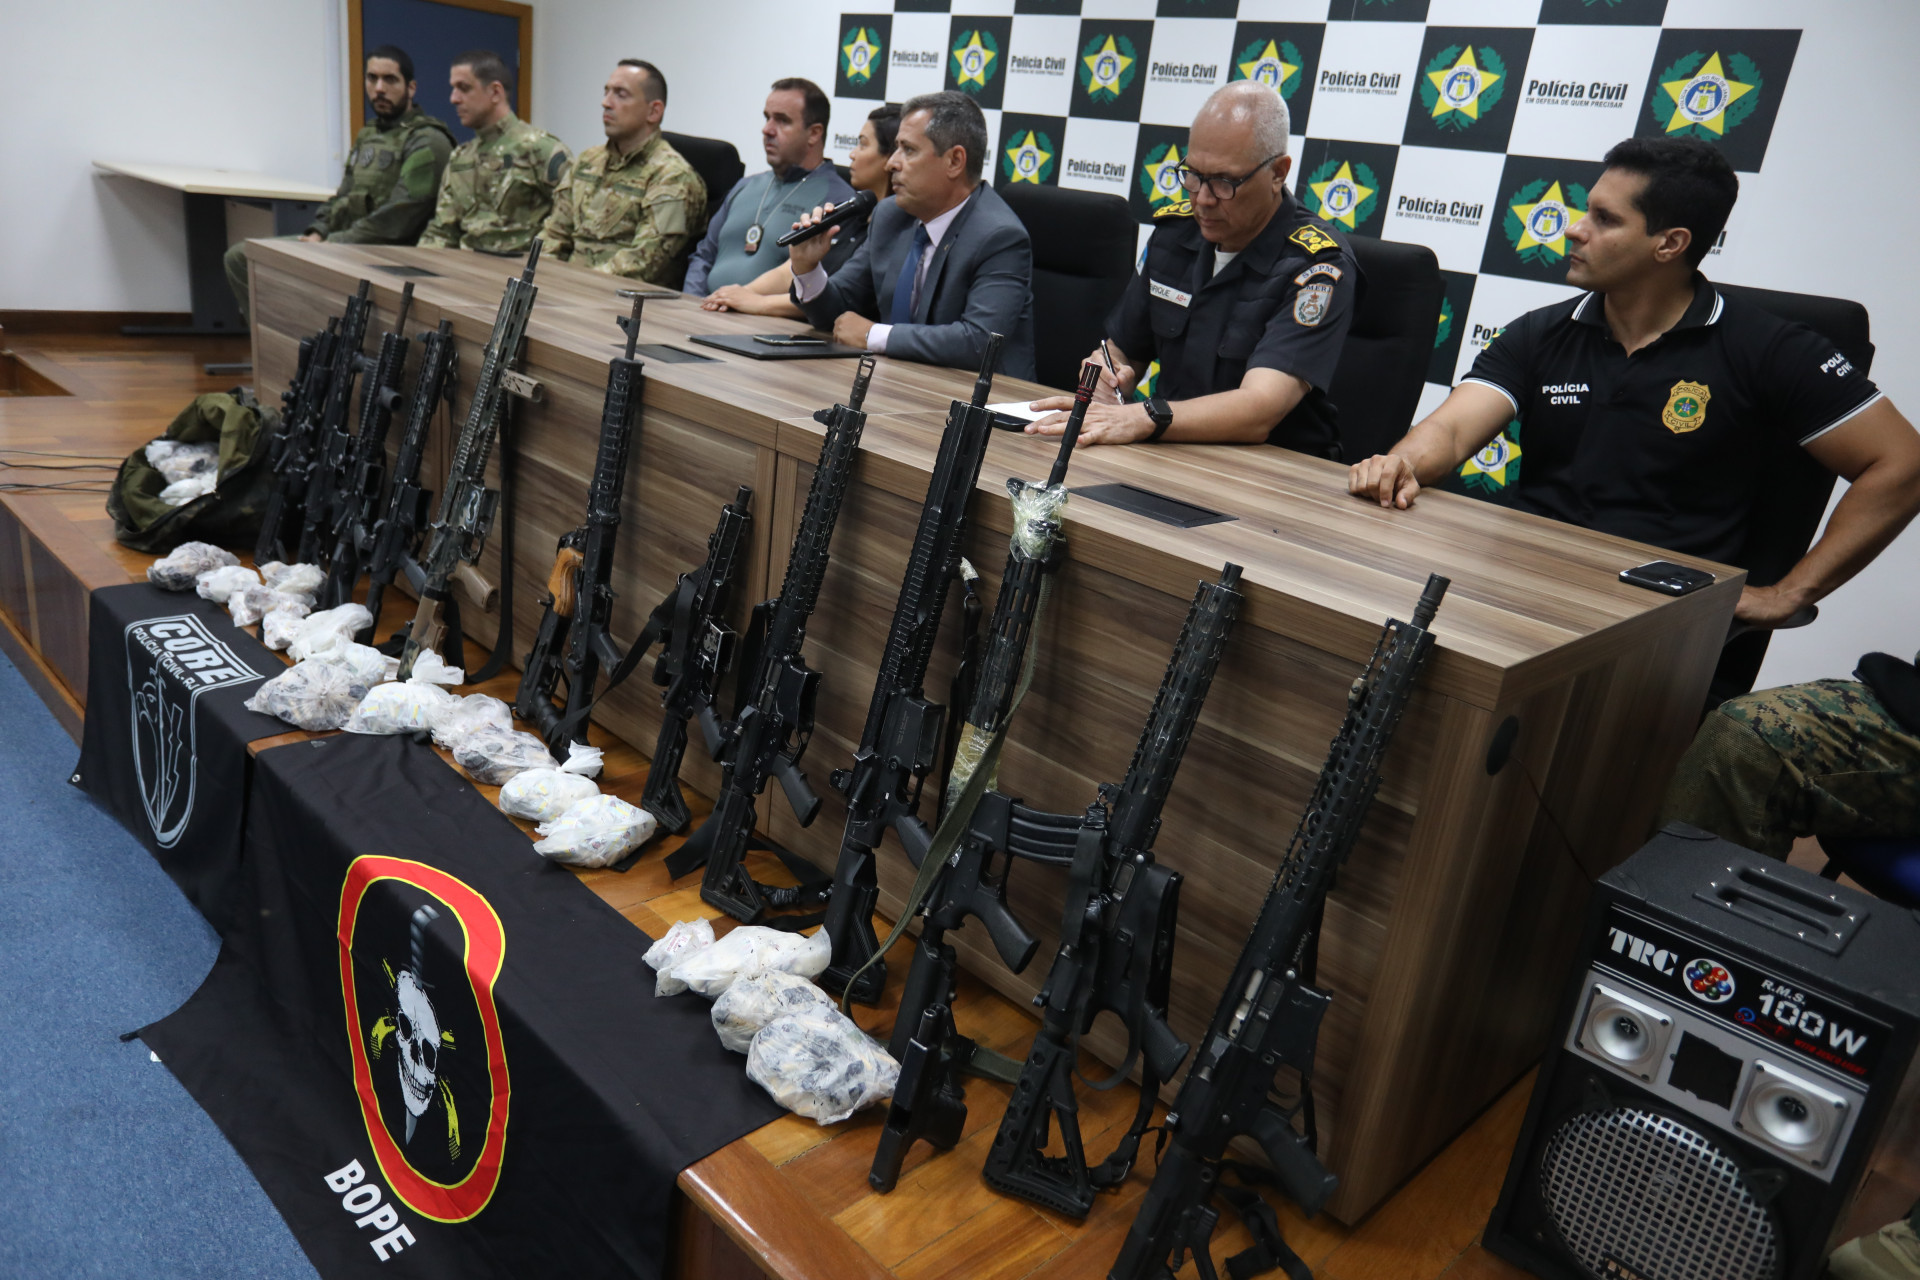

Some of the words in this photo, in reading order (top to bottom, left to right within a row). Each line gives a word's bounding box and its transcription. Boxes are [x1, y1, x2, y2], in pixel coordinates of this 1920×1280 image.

[1011, 55, 1042, 68] Polícia
[1044, 57, 1066, 70] Civil
[1151, 62, 1189, 77] Polícia
[1192, 64, 1218, 79] Civil
[1321, 70, 1367, 87] Polícia
[1369, 72, 1401, 88] Civil
[1527, 79, 1585, 98] Polícia
[1588, 82, 1628, 100] Civil
[1068, 159, 1101, 174] Polícia
[1103, 163, 1126, 177] Civil
[1397, 195, 1447, 215] Polícia
[1450, 201, 1484, 219] Civil
[1302, 265, 1334, 279] SEPM
[1542, 382, 1590, 394] POLÍCIA
[1551, 395, 1581, 405] CIVIL
[132, 627, 162, 658] POLÍCIA
[149, 622, 243, 685] CORE
[1608, 926, 1678, 977] TRC
[323, 1158, 416, 1262] BOPE
